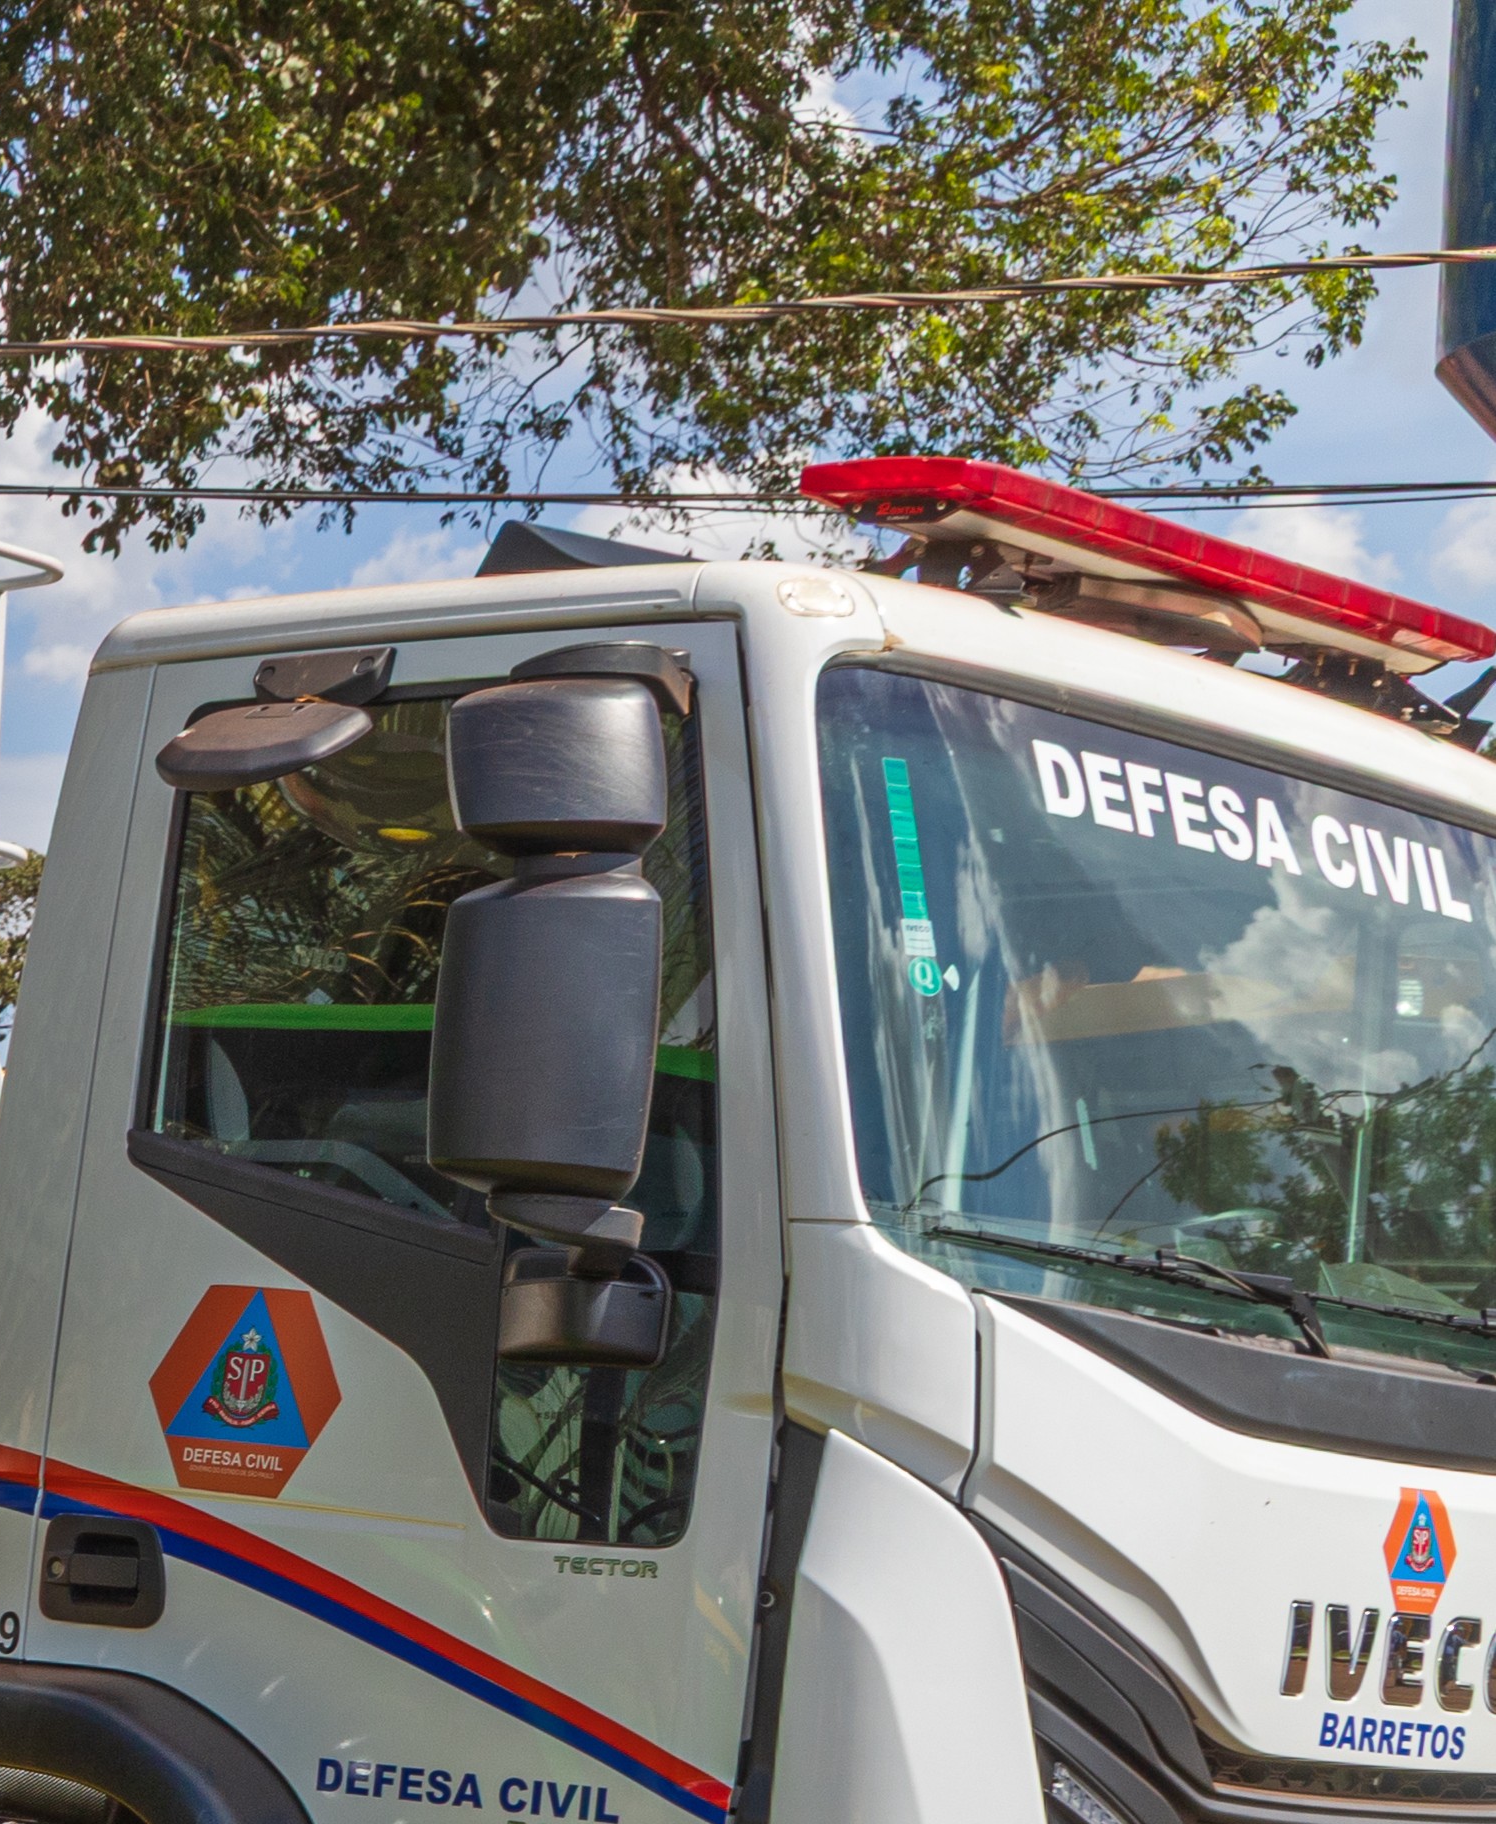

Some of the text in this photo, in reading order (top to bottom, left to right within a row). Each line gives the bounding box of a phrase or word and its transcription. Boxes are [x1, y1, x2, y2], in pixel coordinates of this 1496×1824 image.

[1031, 738, 1474, 923] DEFESA CIVIL
[182, 1447, 283, 1472] DEFESA CIVIL
[553, 1555, 659, 1579] TECTOR
[1279, 1599, 1496, 1715] IVEC
[1318, 1711, 1467, 1761] BARRETOS
[315, 1756, 620, 1824] DEFESA CIVIL
